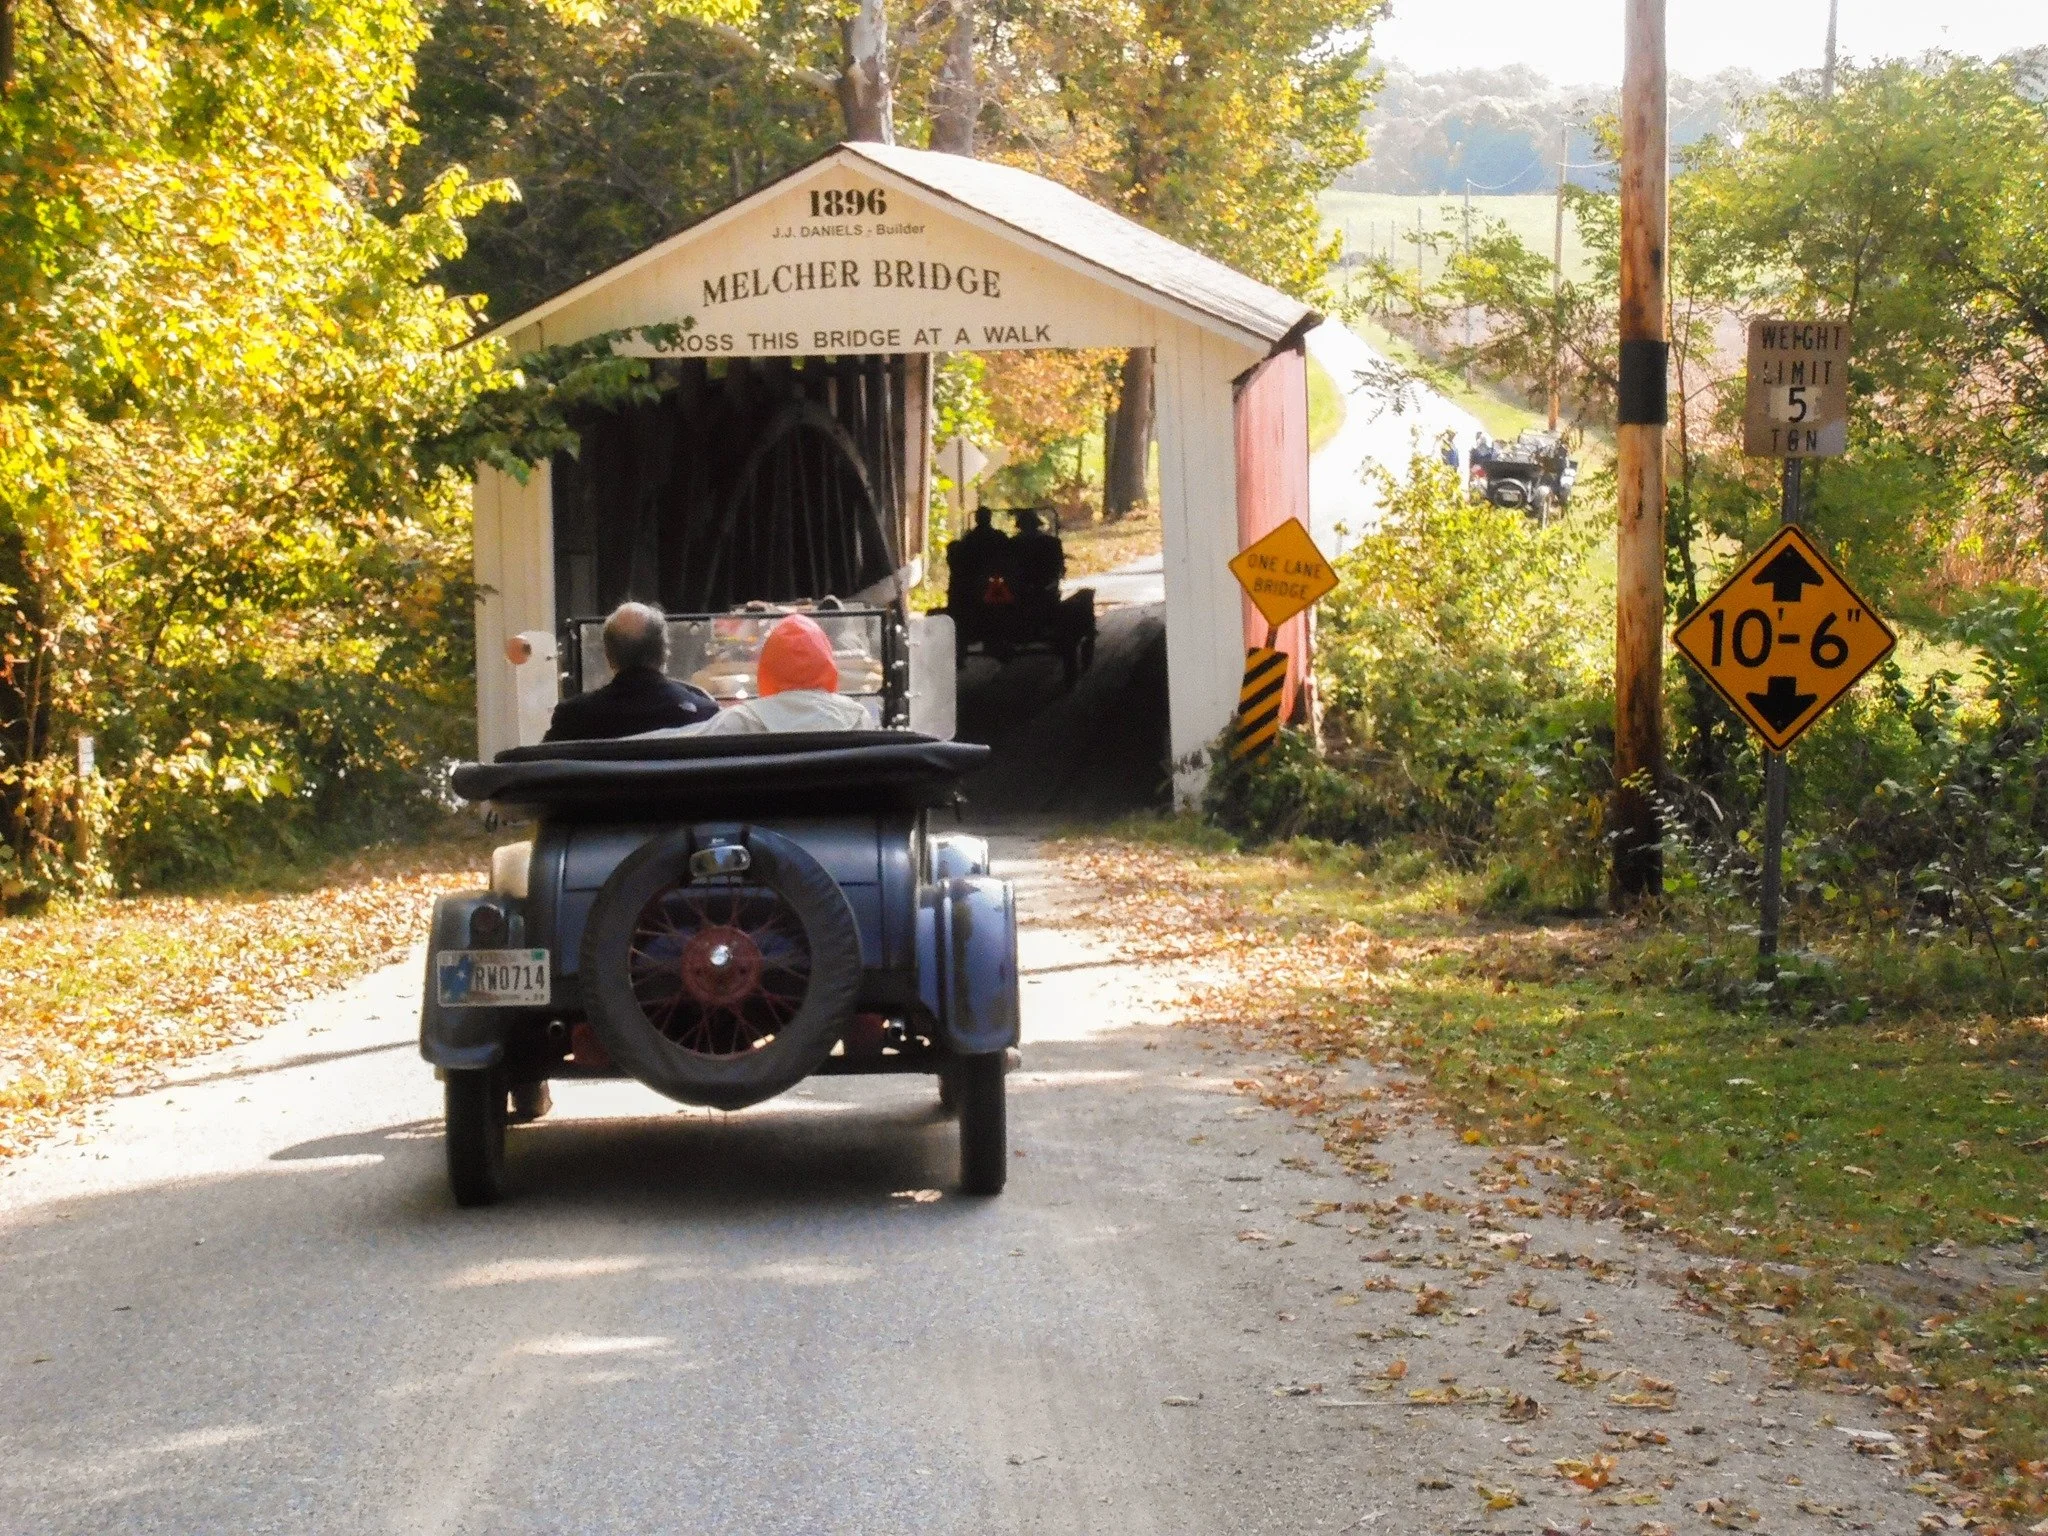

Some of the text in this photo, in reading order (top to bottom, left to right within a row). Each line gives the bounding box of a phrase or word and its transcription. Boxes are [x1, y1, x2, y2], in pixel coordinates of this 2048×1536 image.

[809, 188, 887, 217] 1896
[772, 226, 796, 239] J.J.
[801, 224, 863, 238] DANIELS
[876, 223, 925, 236] Builder
[703, 259, 1001, 307] MELCHER BRIDGE
[749, 332, 799, 350] THIS
[814, 329, 900, 348] BRIDGE
[914, 327, 942, 345] AT
[955, 327, 970, 344] A
[983, 325, 1051, 343] WALK
[1762, 325, 1841, 351] WEIGHT
[1763, 361, 1832, 384] LIMIT
[1788, 387, 1807, 423] 5
[1772, 429, 1817, 452] TON
[1247, 554, 1321, 579] ONE LANE
[1253, 577, 1309, 600] BRIDGE
[475, 965, 545, 991] RW0714
